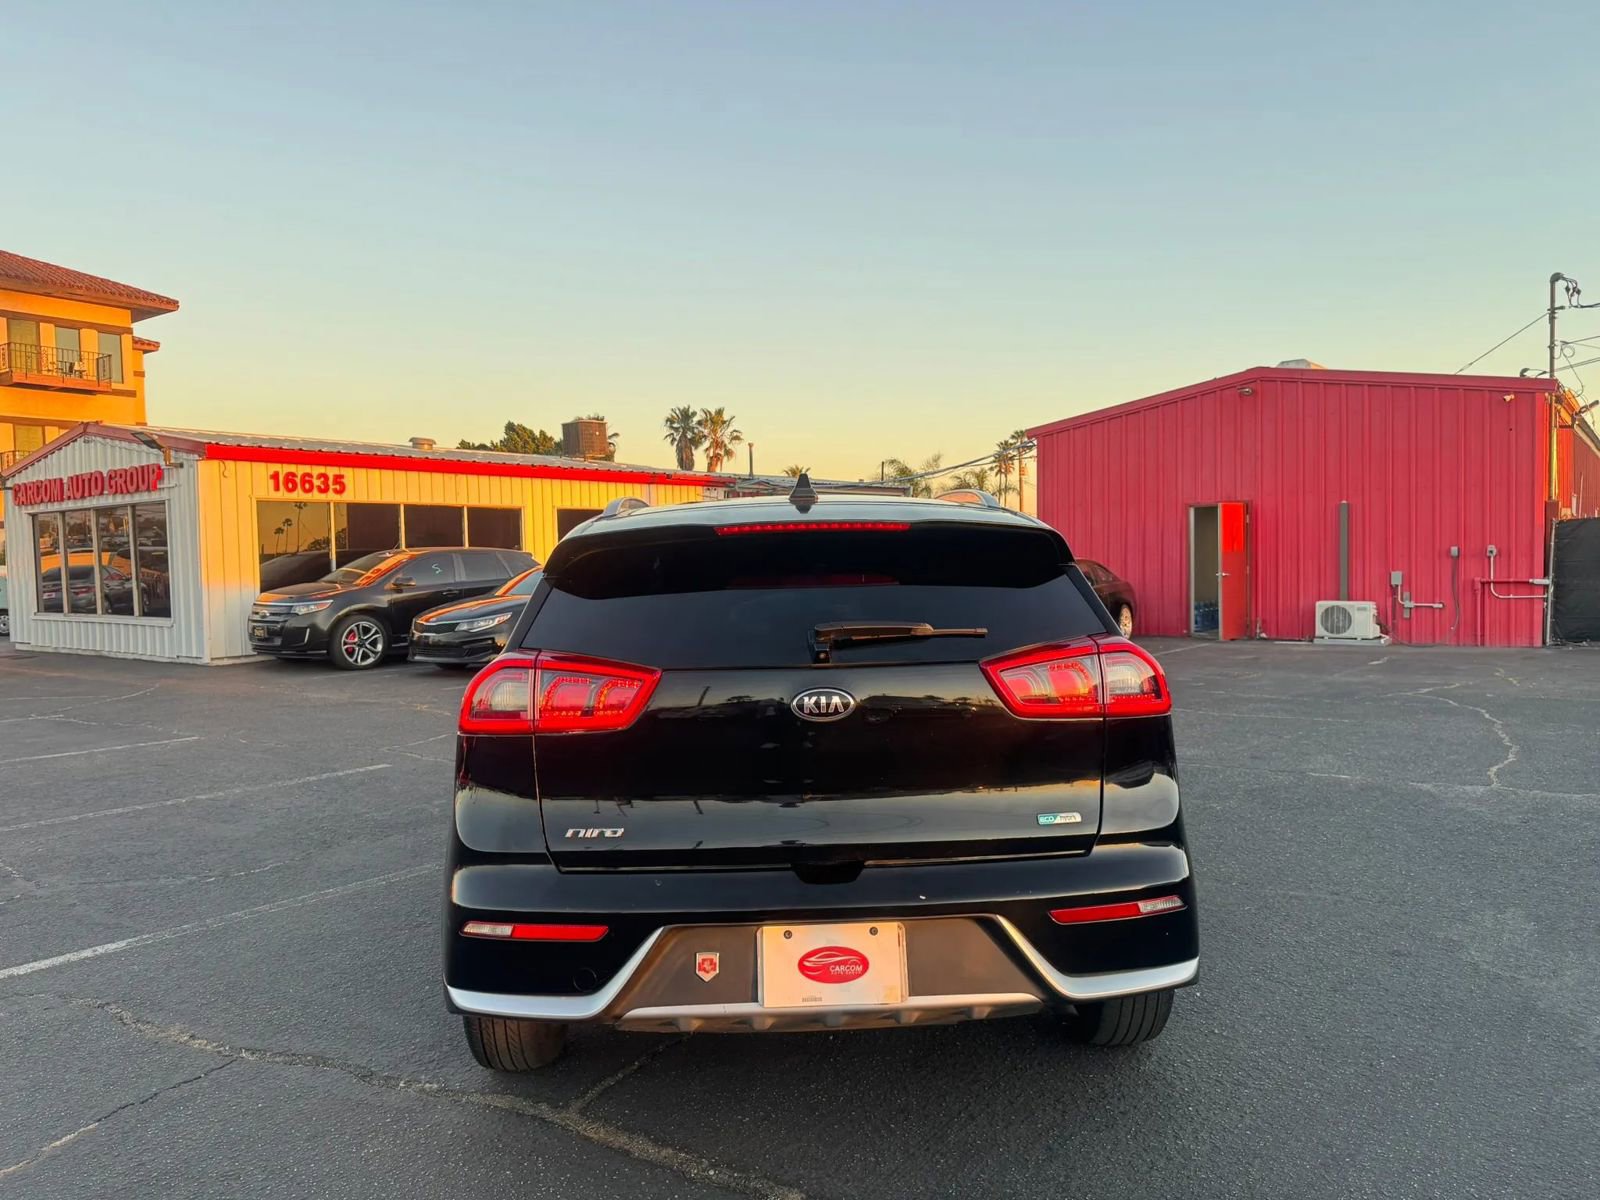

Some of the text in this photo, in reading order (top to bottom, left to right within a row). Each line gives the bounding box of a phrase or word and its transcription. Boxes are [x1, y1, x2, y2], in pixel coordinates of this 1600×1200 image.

[13, 464, 163, 506] CARCOM AUTO GROUP
[269, 470, 346, 495] 16635
[803, 695, 845, 714] KIA
[829, 964, 863, 972] CARCOM
